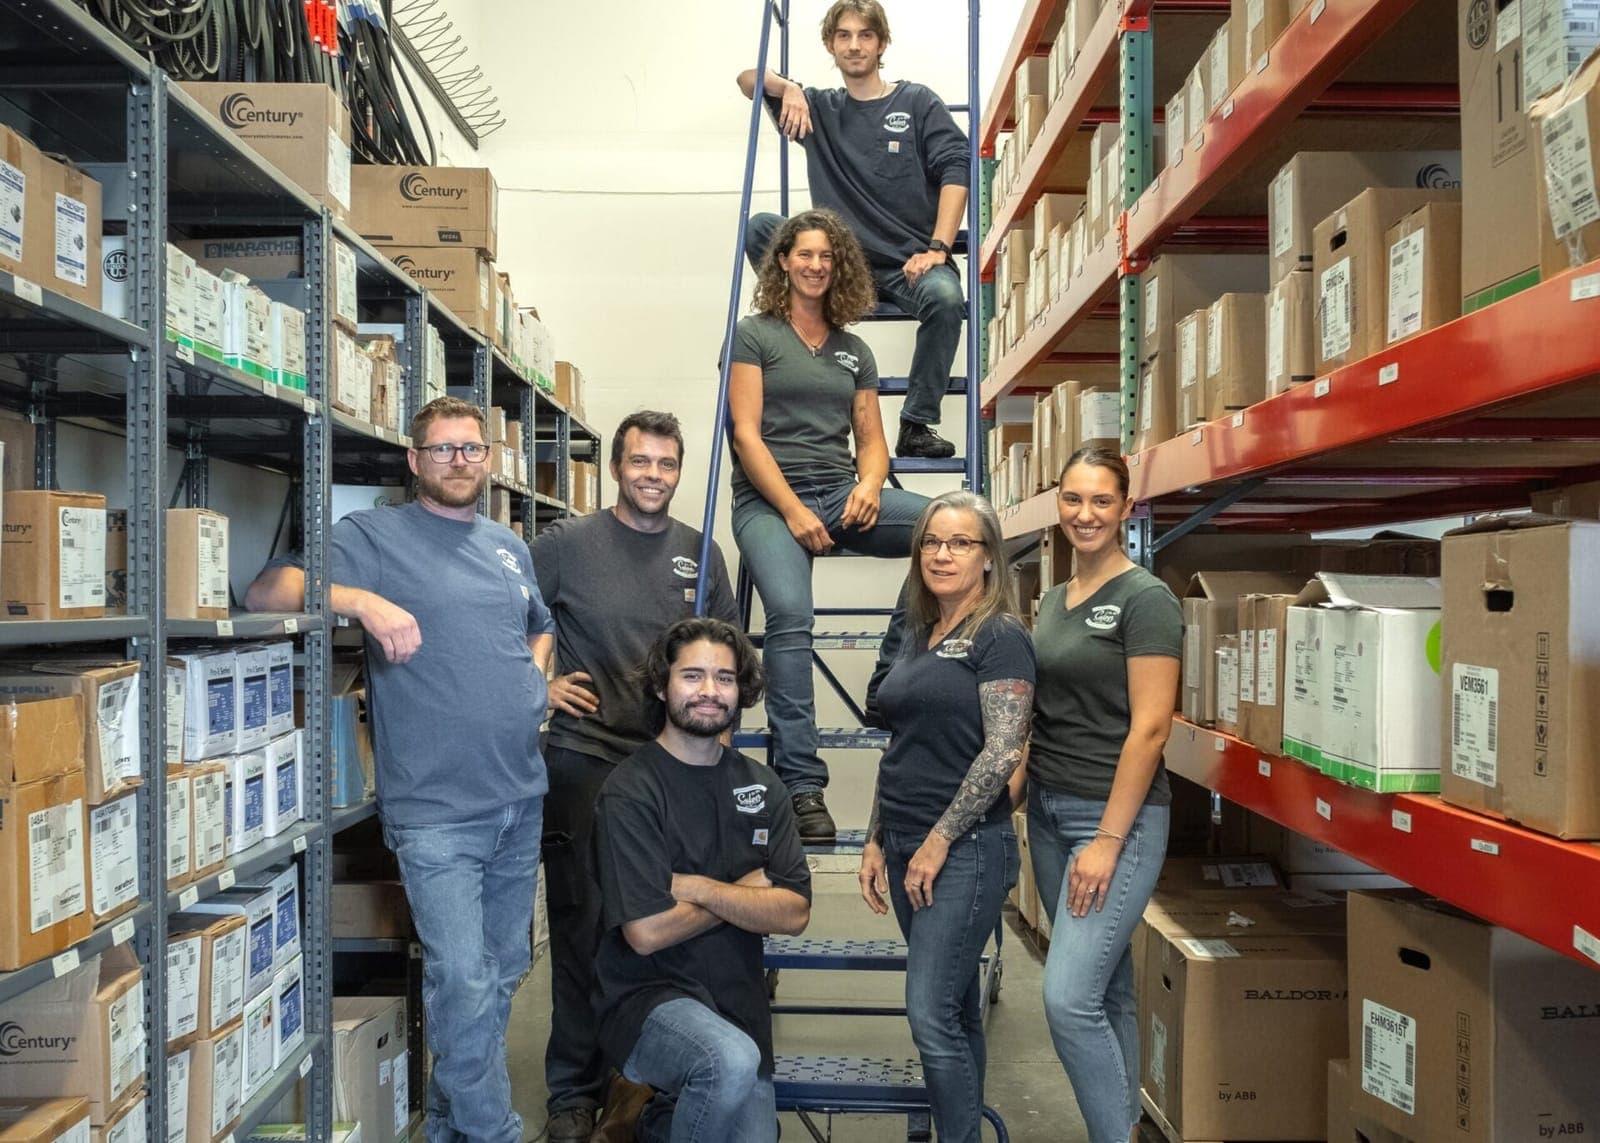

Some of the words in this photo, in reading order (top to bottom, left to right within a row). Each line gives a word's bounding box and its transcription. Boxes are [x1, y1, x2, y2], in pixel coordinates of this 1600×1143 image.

[237, 107, 301, 126] Century
[413, 184, 464, 200] Century
[1460, 674, 1488, 695] VEM3561
[1370, 1012, 1407, 1038] EHM3615T
[8, 1035, 71, 1052] Century
[1218, 1090, 1231, 1103] by
[1235, 1090, 1256, 1101] ABB
[1539, 1124, 1555, 1139] by
[1557, 1121, 1585, 1136] ABB
